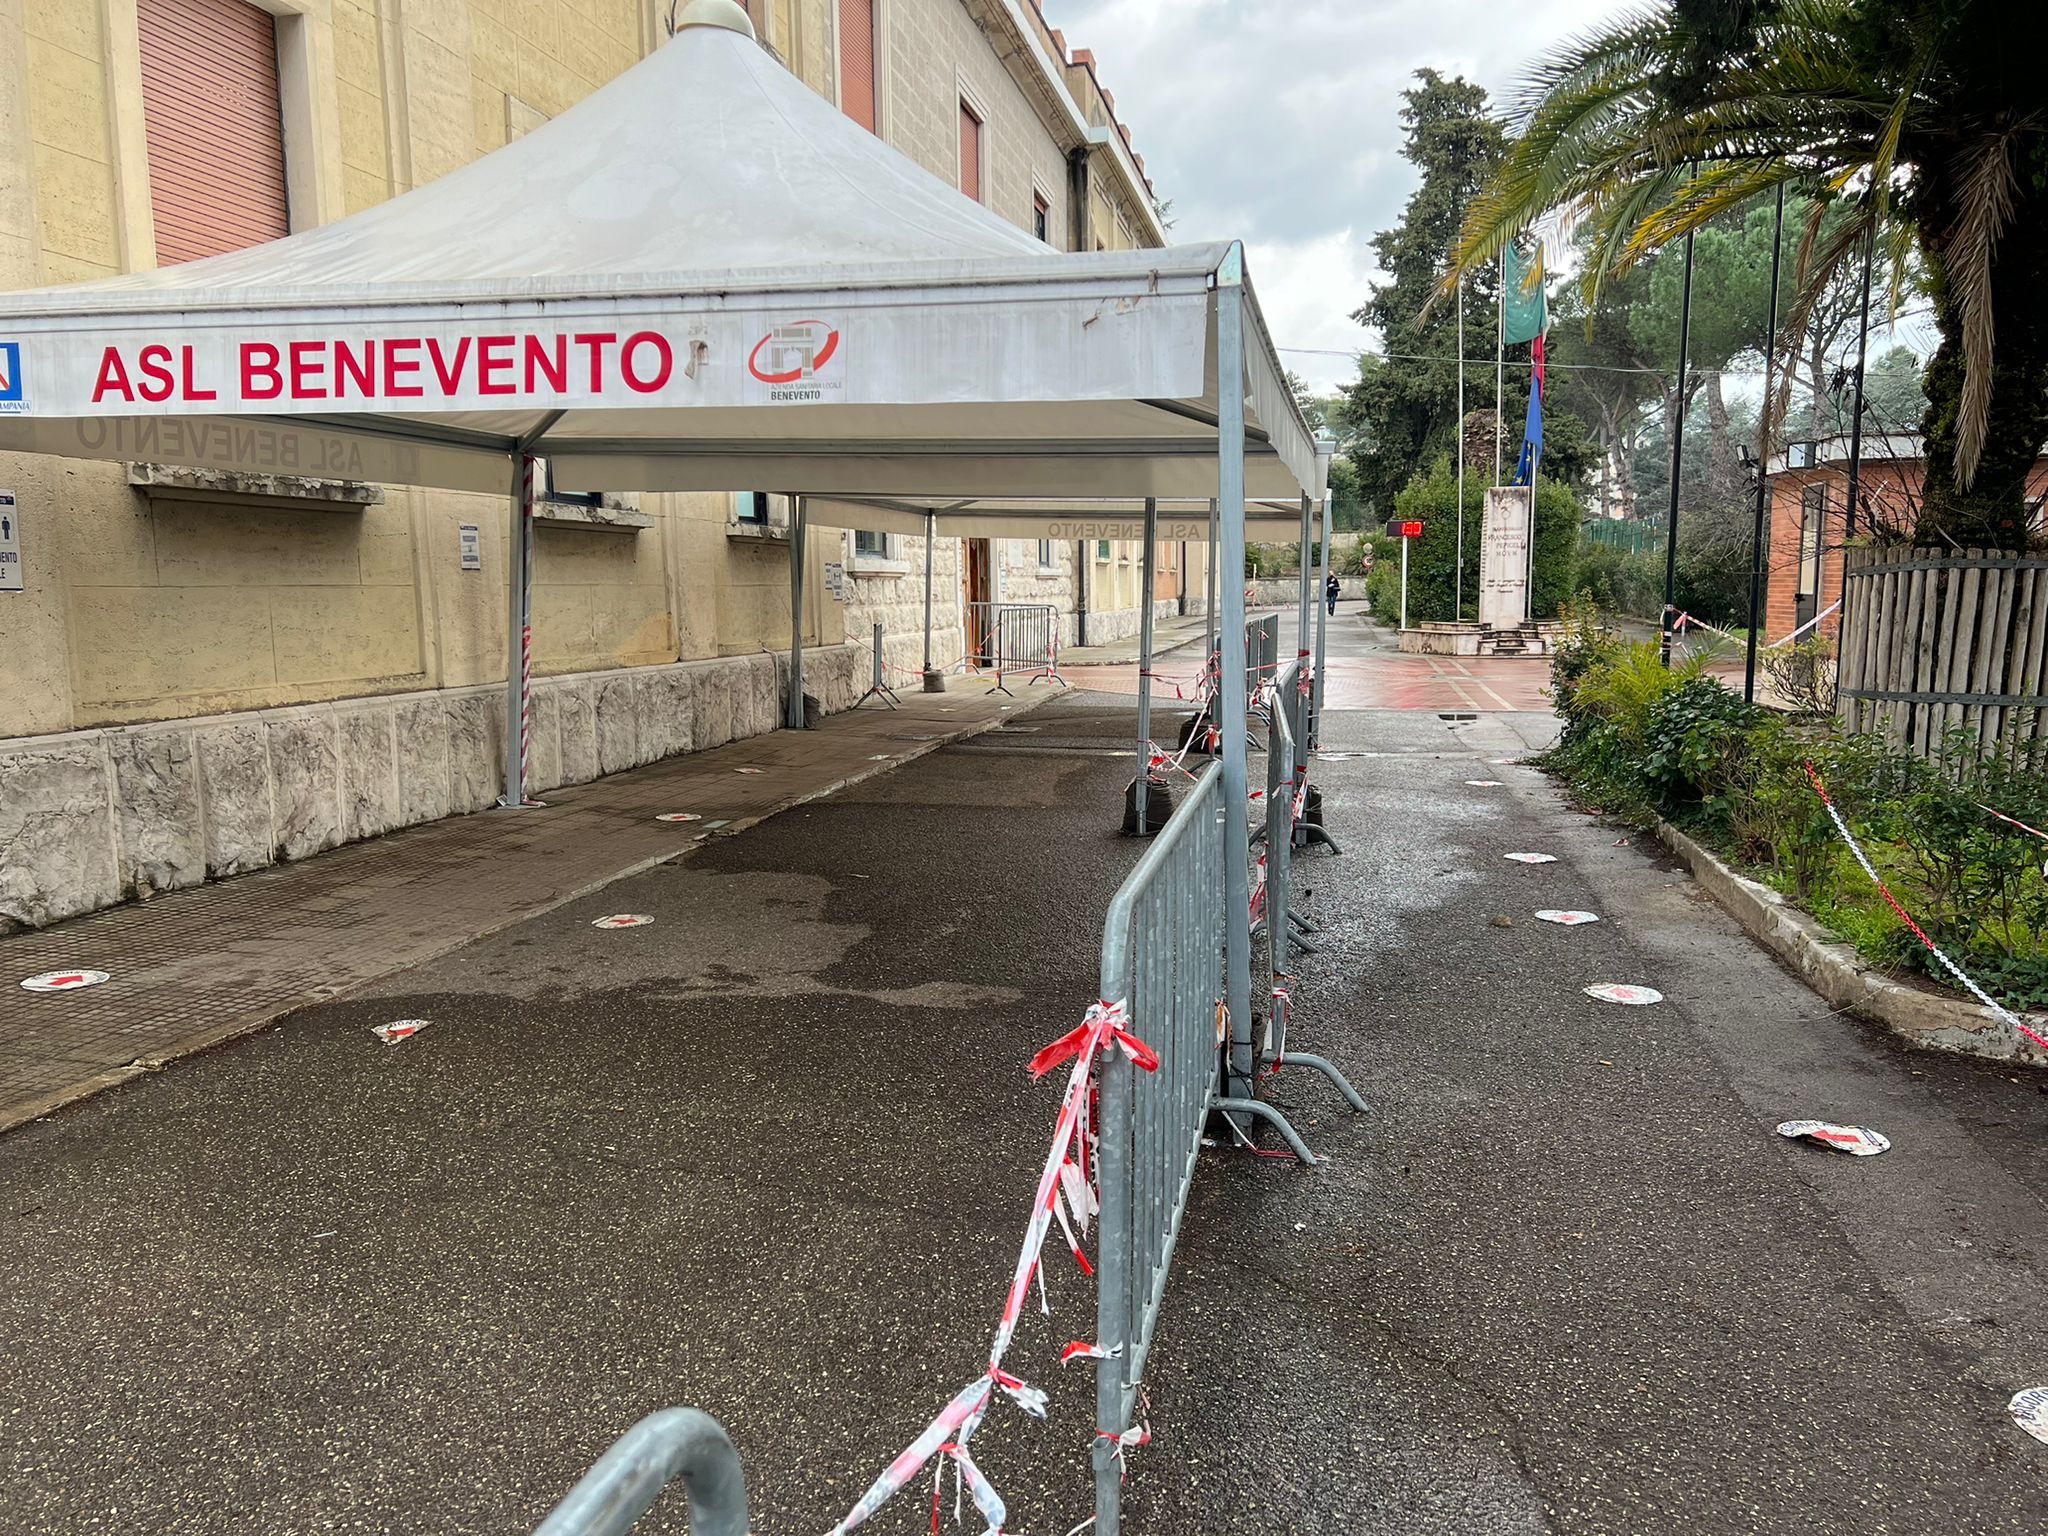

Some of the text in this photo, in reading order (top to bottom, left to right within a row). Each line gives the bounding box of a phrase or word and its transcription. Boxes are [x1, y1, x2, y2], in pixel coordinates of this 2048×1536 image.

[92, 331, 673, 402] ASL BENEVENTO
[771, 390, 821, 401] BENEVENTO
